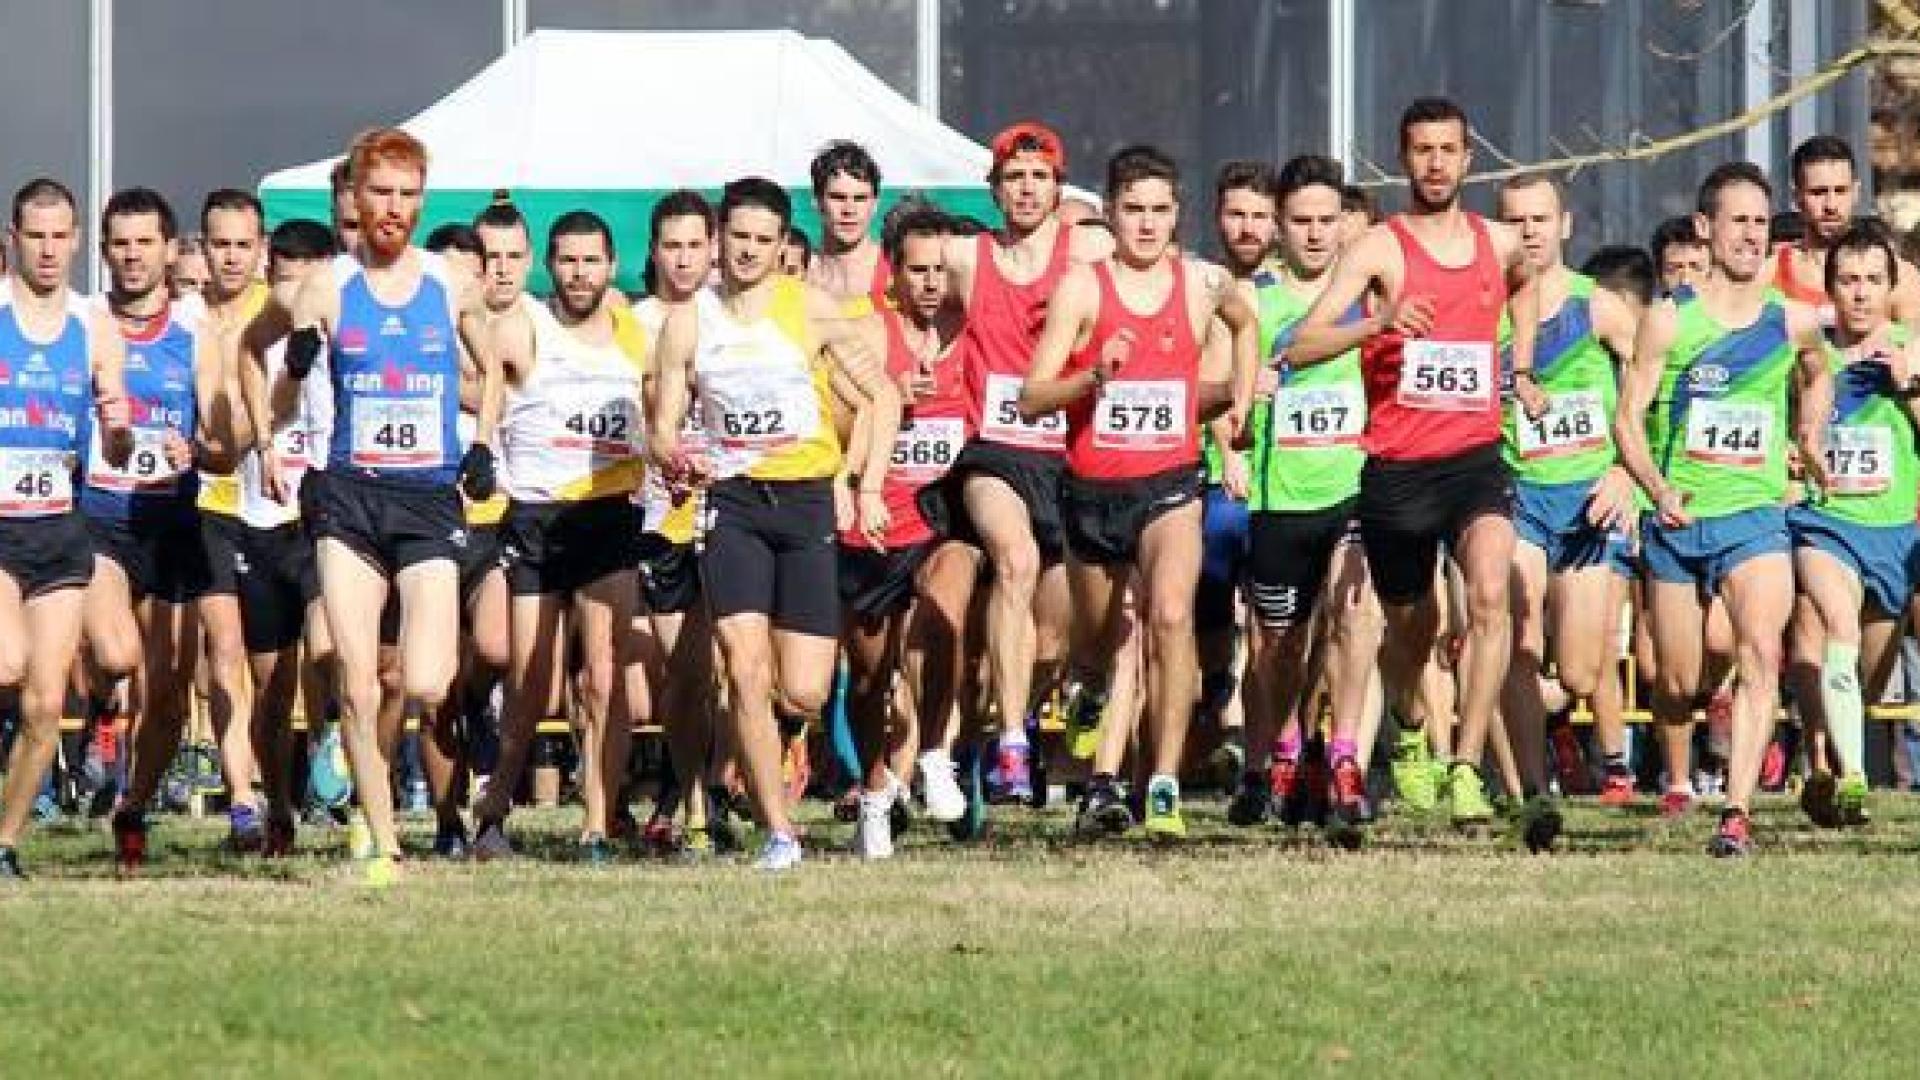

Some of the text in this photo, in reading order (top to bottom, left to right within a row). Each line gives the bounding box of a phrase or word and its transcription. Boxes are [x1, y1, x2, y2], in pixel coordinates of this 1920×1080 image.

[1416, 367, 1478, 392] 563
[565, 413, 627, 439] 402
[724, 411, 783, 435] 622
[1109, 404, 1172, 431] 578
[1289, 407, 1348, 434] 167
[1530, 411, 1593, 443] 148
[374, 424, 417, 448] 48
[1704, 426, 1760, 451] 144
[891, 440, 950, 465] 568
[1825, 449, 1879, 475] 175
[16, 474, 52, 497] 46
